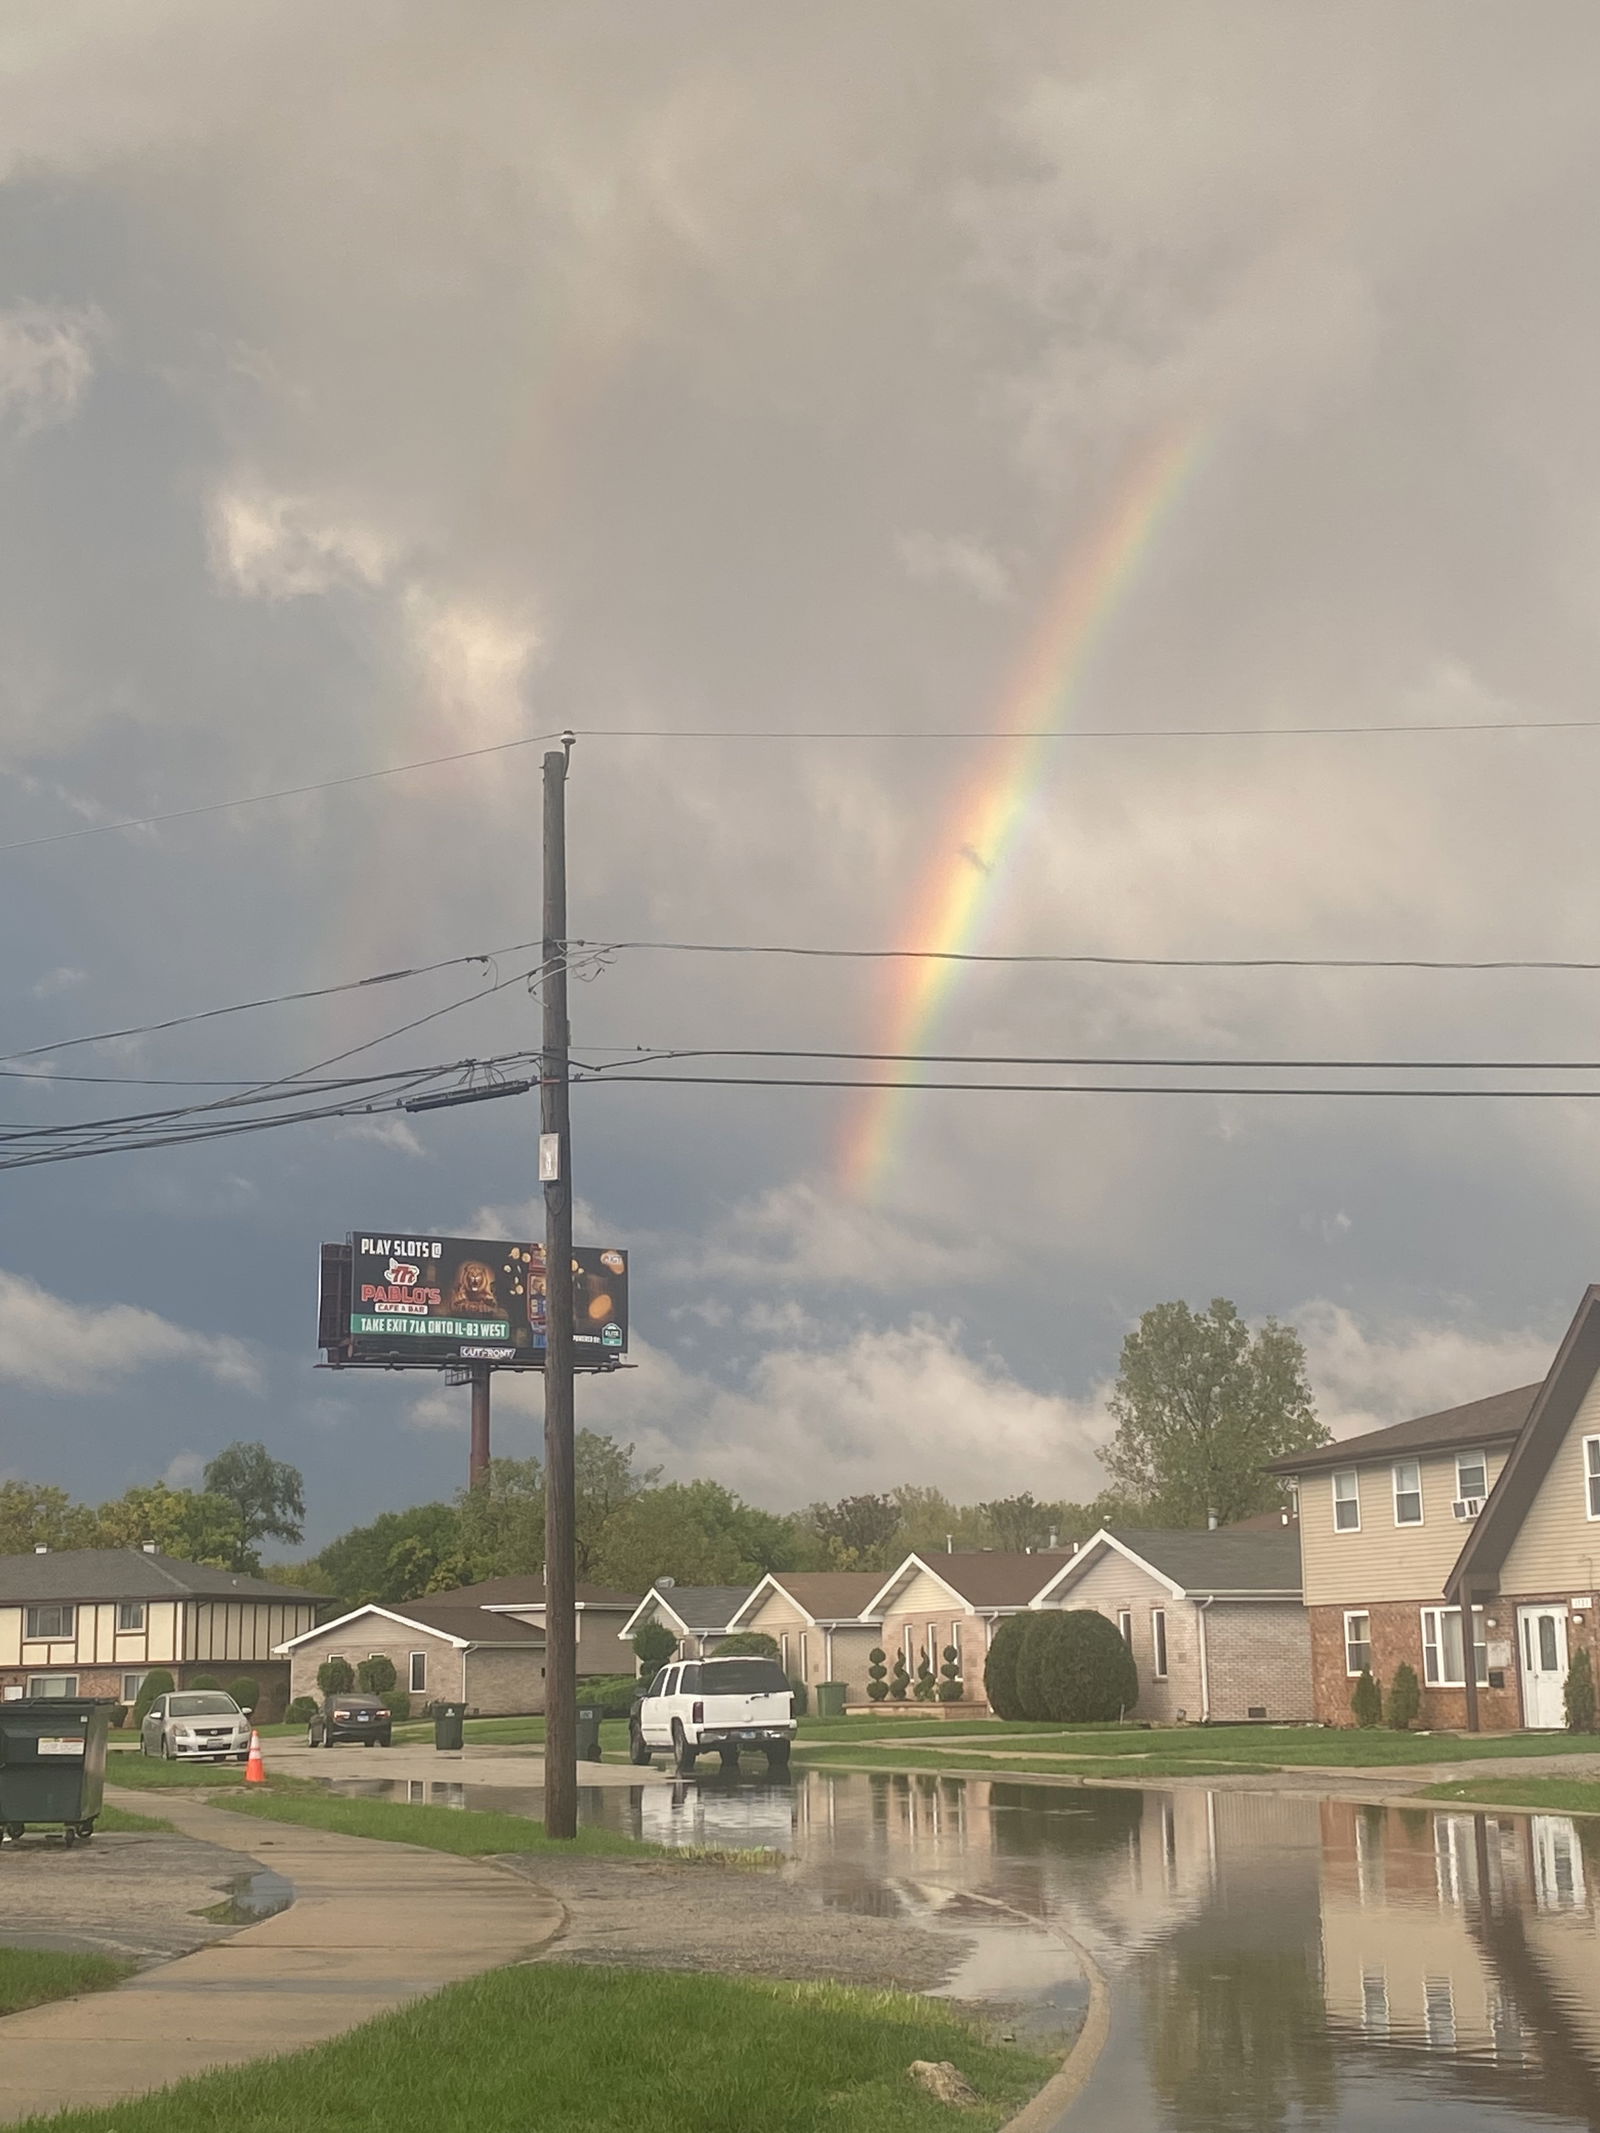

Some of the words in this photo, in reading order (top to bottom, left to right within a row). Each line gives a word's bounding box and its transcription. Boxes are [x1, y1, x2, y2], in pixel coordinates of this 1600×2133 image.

[361, 1238, 392, 1255] PLAY
[394, 1240, 429, 1258] SLOTS
[431, 1242, 442, 1258] @
[361, 1284, 441, 1304] PABLO'S
[378, 1303, 400, 1312] CAFE
[408, 1305, 425, 1313] BAR
[361, 1318, 385, 1331] TAKE
[386, 1319, 407, 1332] EXIT
[409, 1320, 426, 1334] 71A
[428, 1321, 453, 1334] ONTO
[455, 1322, 478, 1336] IL-83
[480, 1323, 506, 1337] WEST
